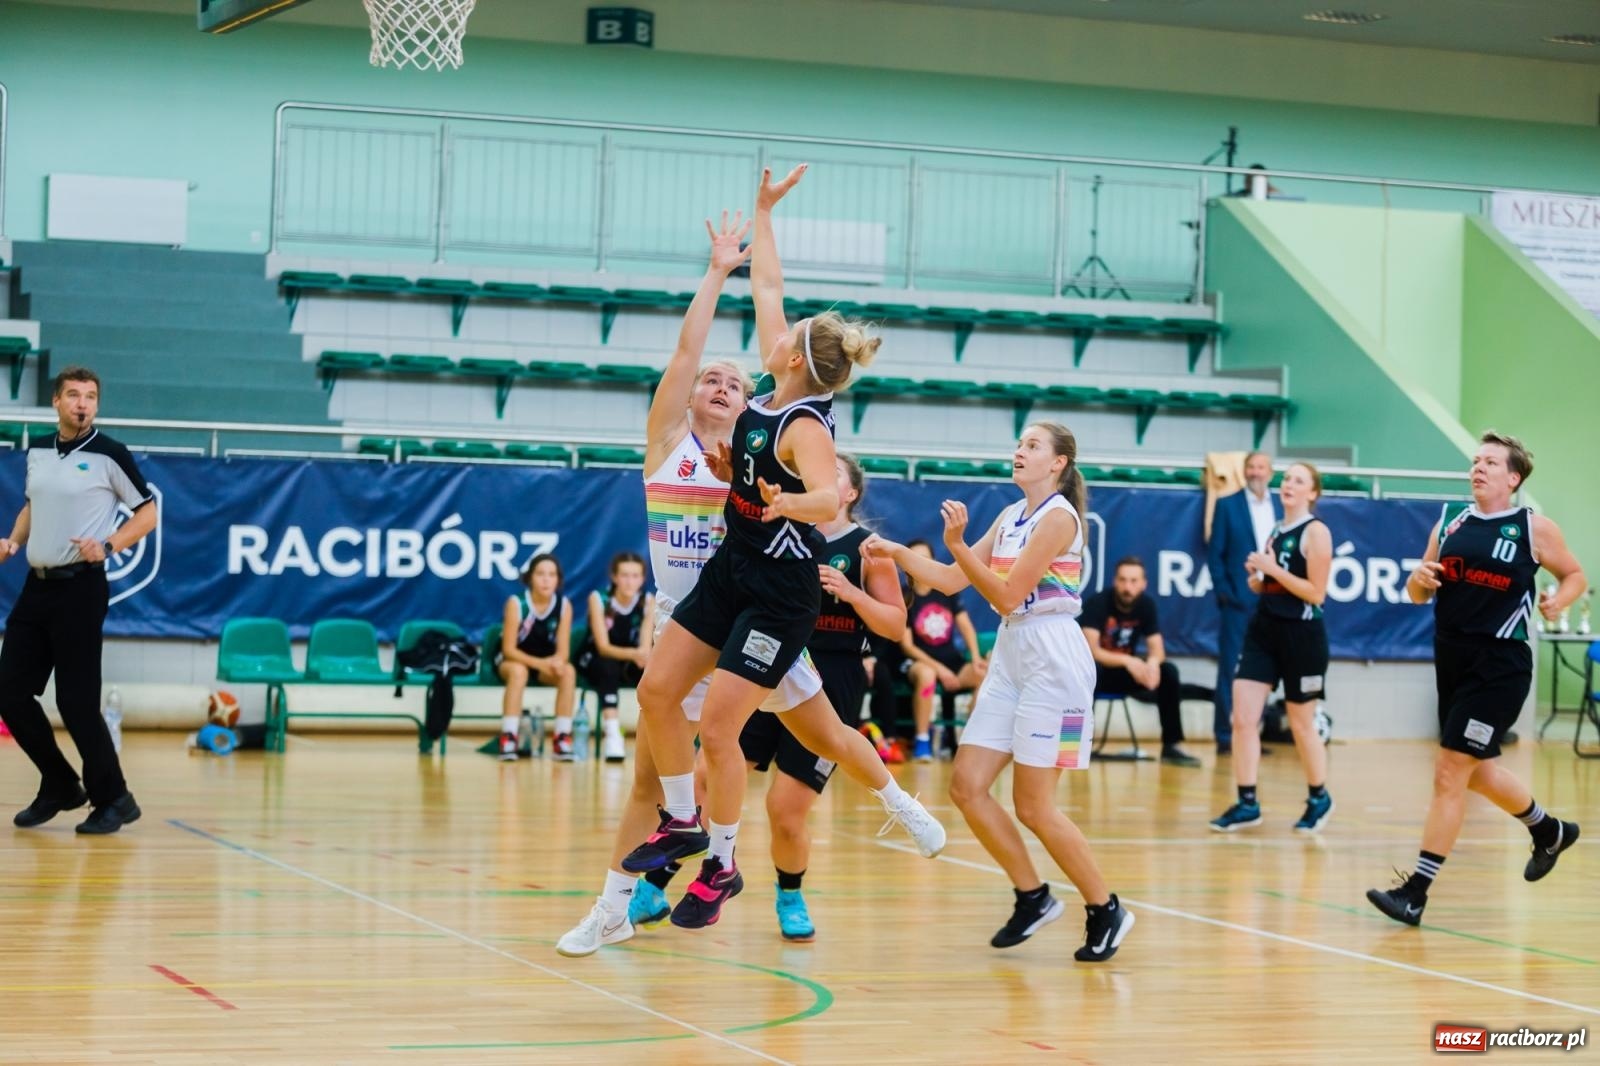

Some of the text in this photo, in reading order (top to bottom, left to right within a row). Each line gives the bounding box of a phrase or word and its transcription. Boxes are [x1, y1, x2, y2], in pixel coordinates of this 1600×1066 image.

[597, 20, 621, 40] B
[636, 21, 649, 42] B
[743, 452, 755, 486] 3
[1491, 538, 1517, 563] 10
[667, 560, 689, 568] MORE
[1278, 551, 1291, 572] 5
